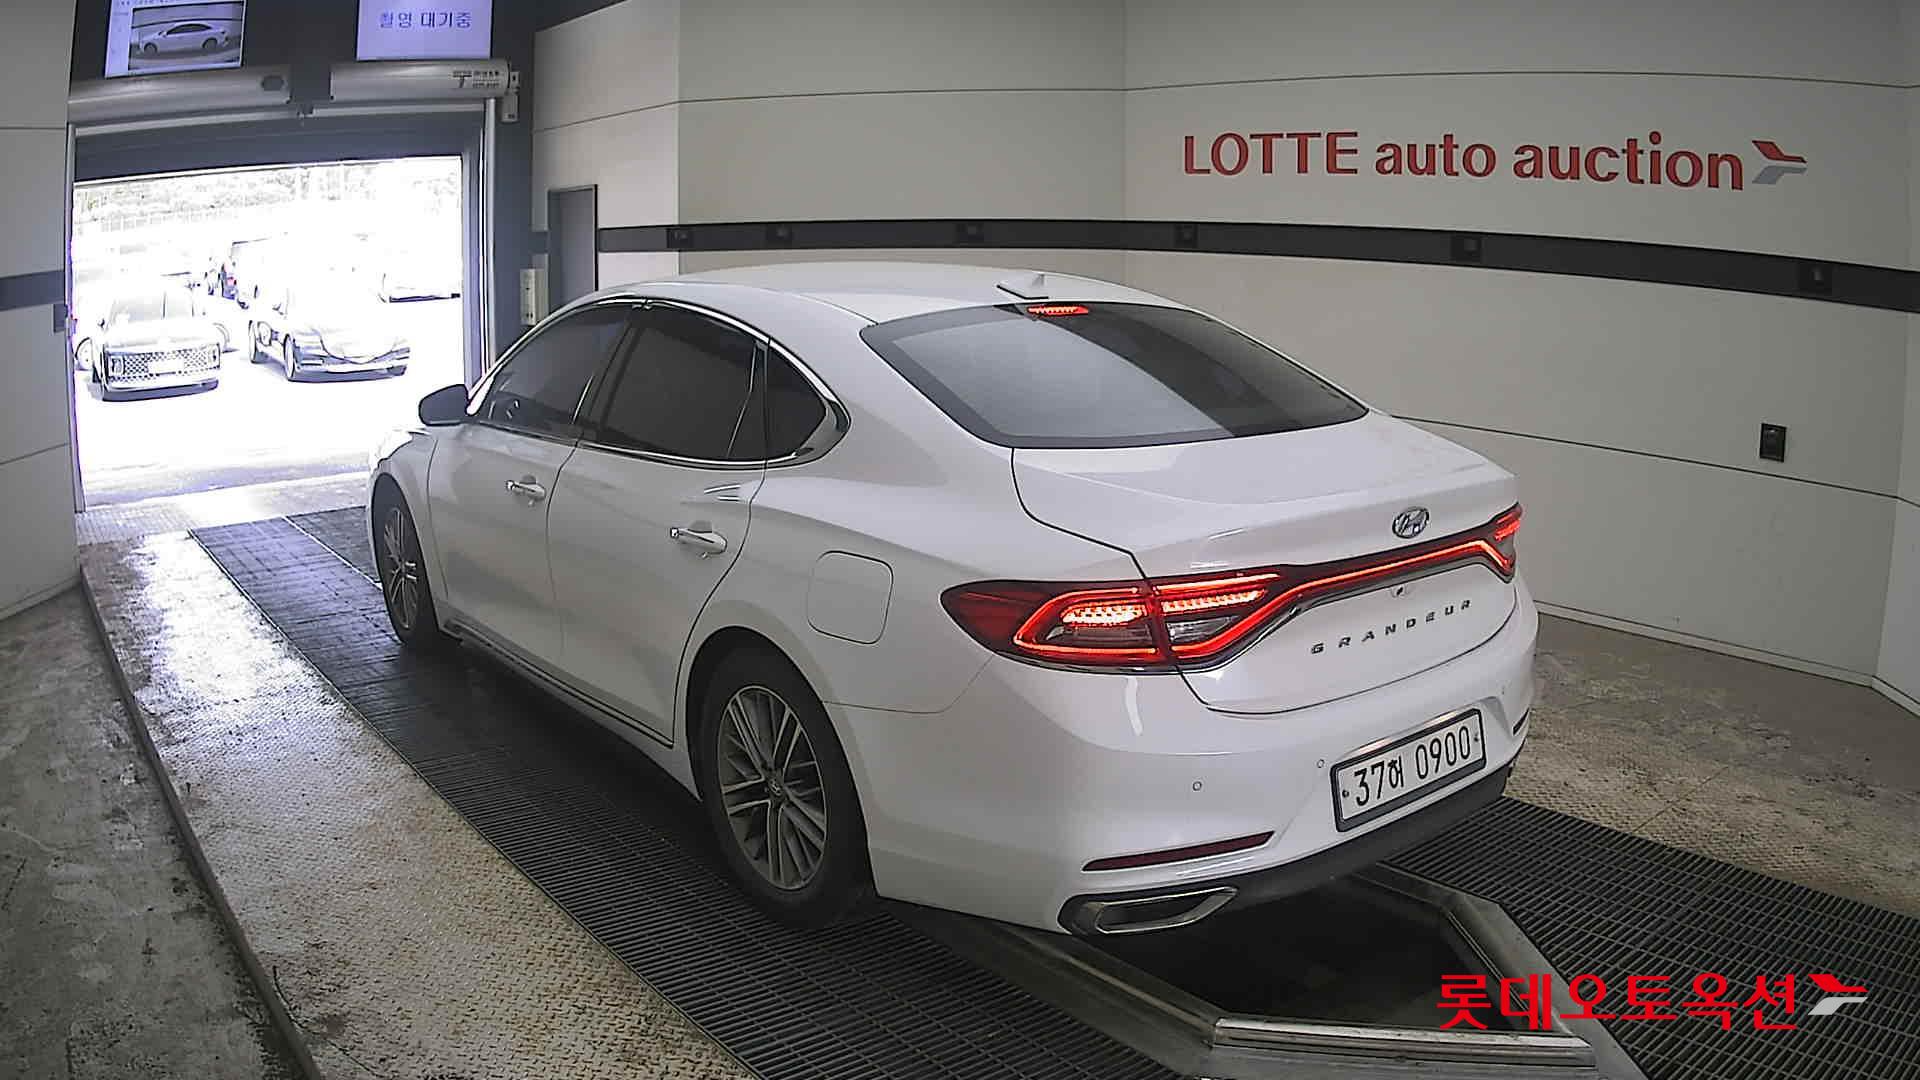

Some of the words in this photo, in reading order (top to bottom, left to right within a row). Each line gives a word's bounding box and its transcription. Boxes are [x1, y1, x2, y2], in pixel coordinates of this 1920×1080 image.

[420, 11, 472, 29] 대기중
[1184, 131, 1359, 177] LOTTE
[1375, 134, 1498, 178] auto
[1513, 131, 1745, 190] auction
[1310, 599, 1472, 655] GRANDEUR
[1353, 755, 1405, 807] 37허
[1415, 725, 1471, 780] 0900
